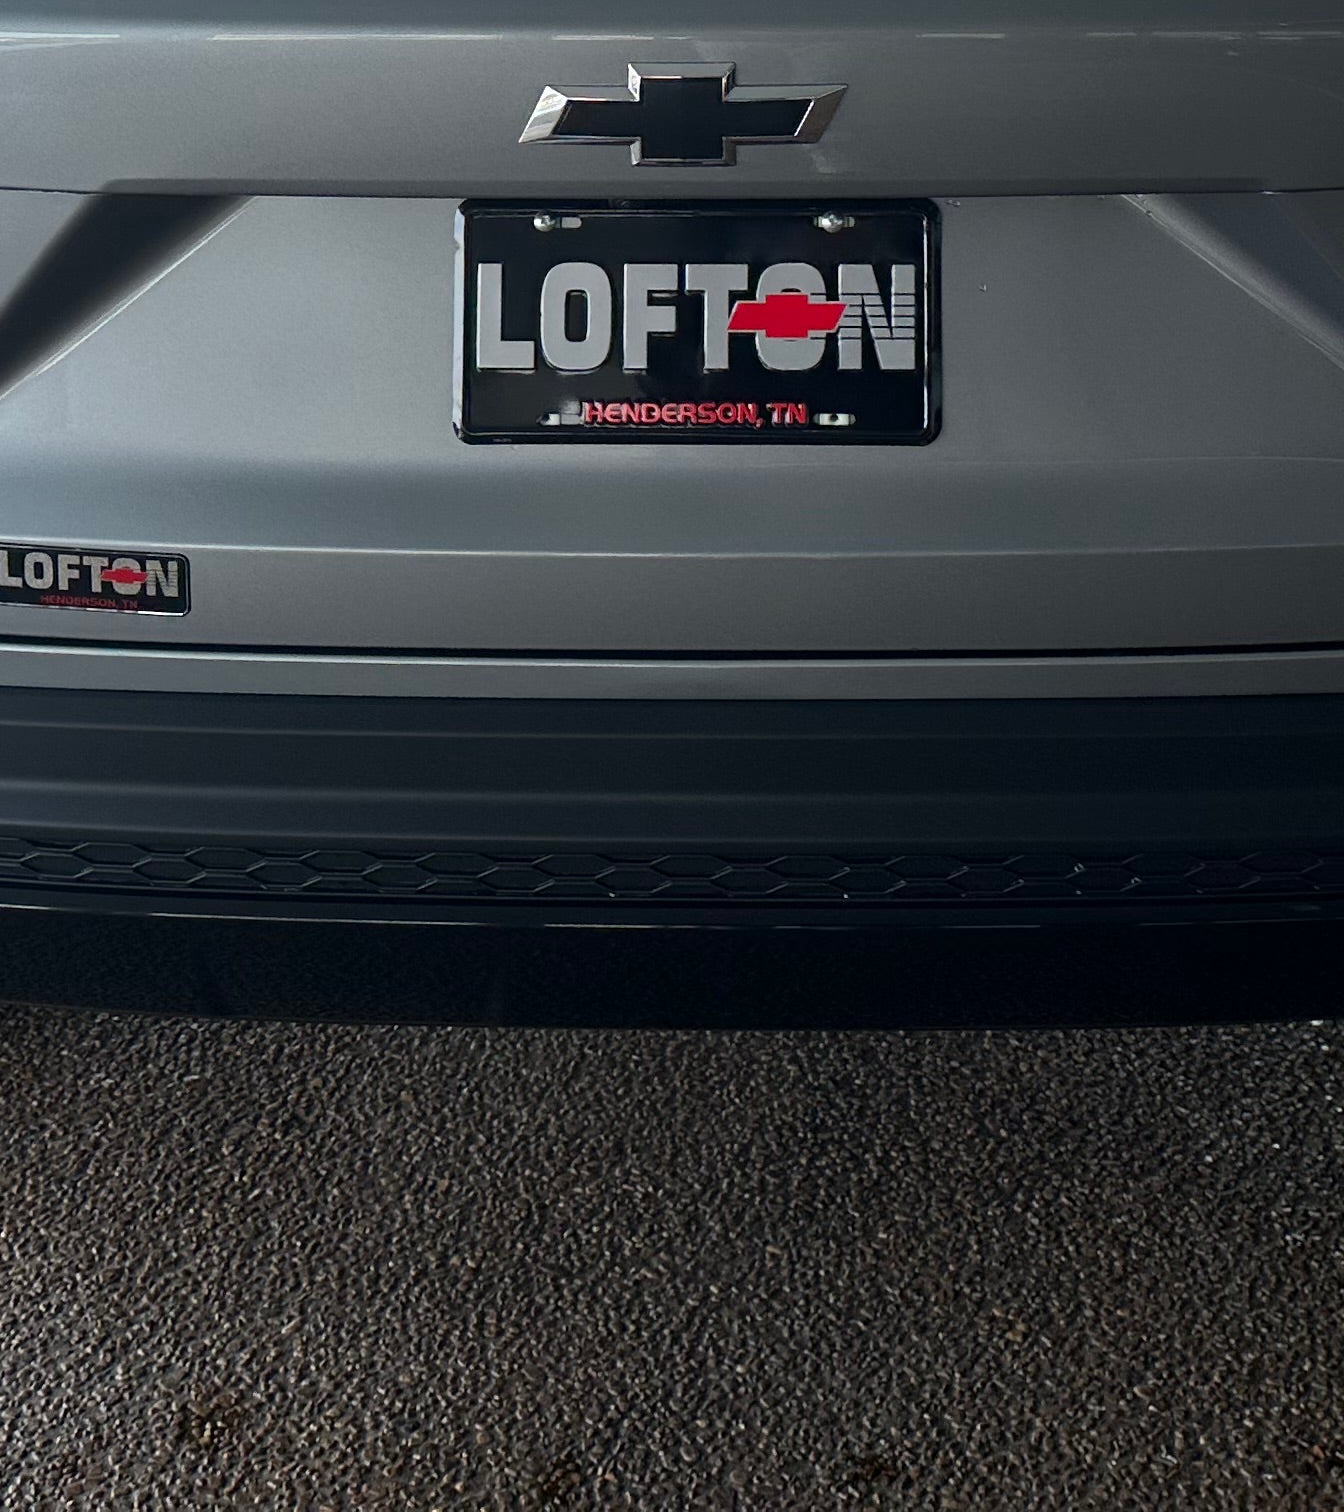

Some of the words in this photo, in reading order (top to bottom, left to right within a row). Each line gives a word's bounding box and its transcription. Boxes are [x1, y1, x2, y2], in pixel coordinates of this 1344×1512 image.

[475, 262, 917, 371] LOFTON
[583, 402, 764, 428] HENDERSON,
[771, 402, 808, 425] TN
[121, 599, 138, 609] TN
